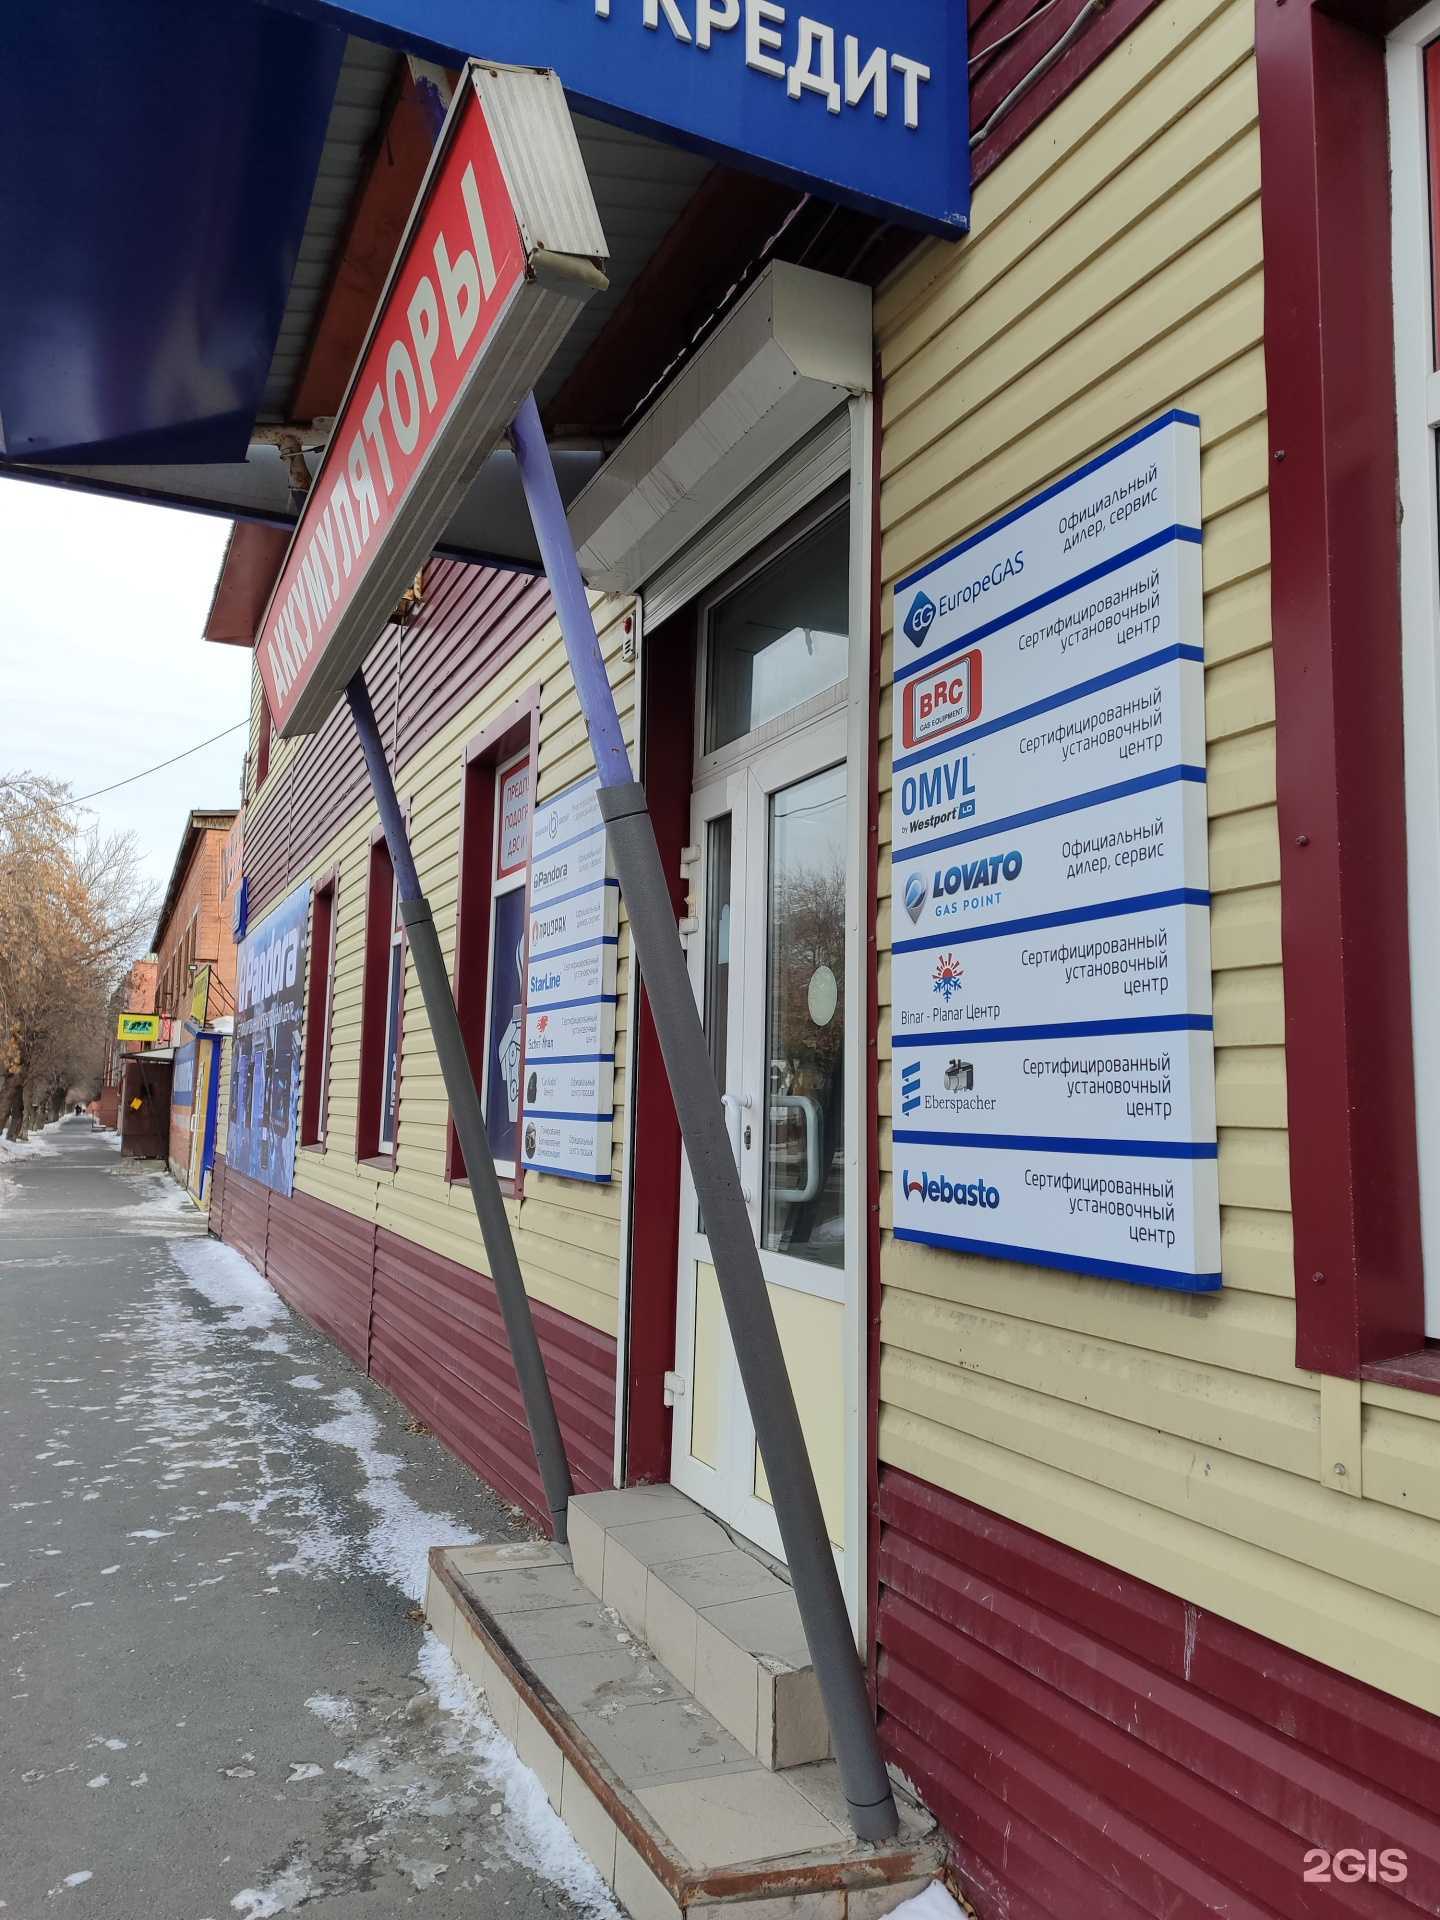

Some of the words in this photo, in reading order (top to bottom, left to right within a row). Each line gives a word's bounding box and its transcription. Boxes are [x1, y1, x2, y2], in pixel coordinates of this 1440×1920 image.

[266, 160, 498, 709] АККУМУЛЯТОРЫ
[1058, 463, 1158, 535] Официальный
[1063, 519, 1107, 553] дилер,
[1109, 487, 1159, 525] сервис
[939, 550, 1025, 617] EuropeGAS
[1018, 568, 1160, 651] Сертифицированный
[1060, 590, 1160, 654] установочный
[1117, 615, 1161, 645] центр
[919, 678, 963, 720] BRC
[919, 720, 931, 732] GAS
[931, 706, 965, 727] EQUIPMENT
[1019, 686, 1162, 754] Сертифицированный
[1061, 707, 1162, 762] установочный
[1119, 733, 1163, 760] центр
[901, 756, 976, 816] OMVL
[909, 807, 957, 834] Westport
[961, 804, 973, 814] LD
[1062, 816, 1164, 859] Официальный
[537, 863, 568, 886] Pandora
[932, 850, 1023, 898] LOVATO
[1066, 856, 1111, 880] дилер,
[1114, 842, 1164, 867] сервис
[935, 904, 958, 917] GAS
[963, 892, 1002, 911] POINT
[1021, 927, 1168, 968] Сертифицированный
[245, 928, 298, 1010] Pandora
[530, 972, 561, 993] StarLine
[1065, 950, 1168, 984] установочный
[1124, 976, 1169, 996] центр
[901, 1010, 924, 1025] Binar
[932, 1007, 963, 1023] Planar
[966, 1004, 1001, 1022] Центр
[1022, 1052, 1171, 1078] Сертифицированный
[1067, 1075, 1171, 1098] установочный
[924, 1095, 997, 1114] Eberspacher
[1126, 1101, 1172, 1120] центр
[902, 1169, 1000, 1209] Webasto
[1024, 1168, 1174, 1199] Сертифицированный
[1069, 1197, 1175, 1222] установочный
[1129, 1225, 1176, 1248] центр
